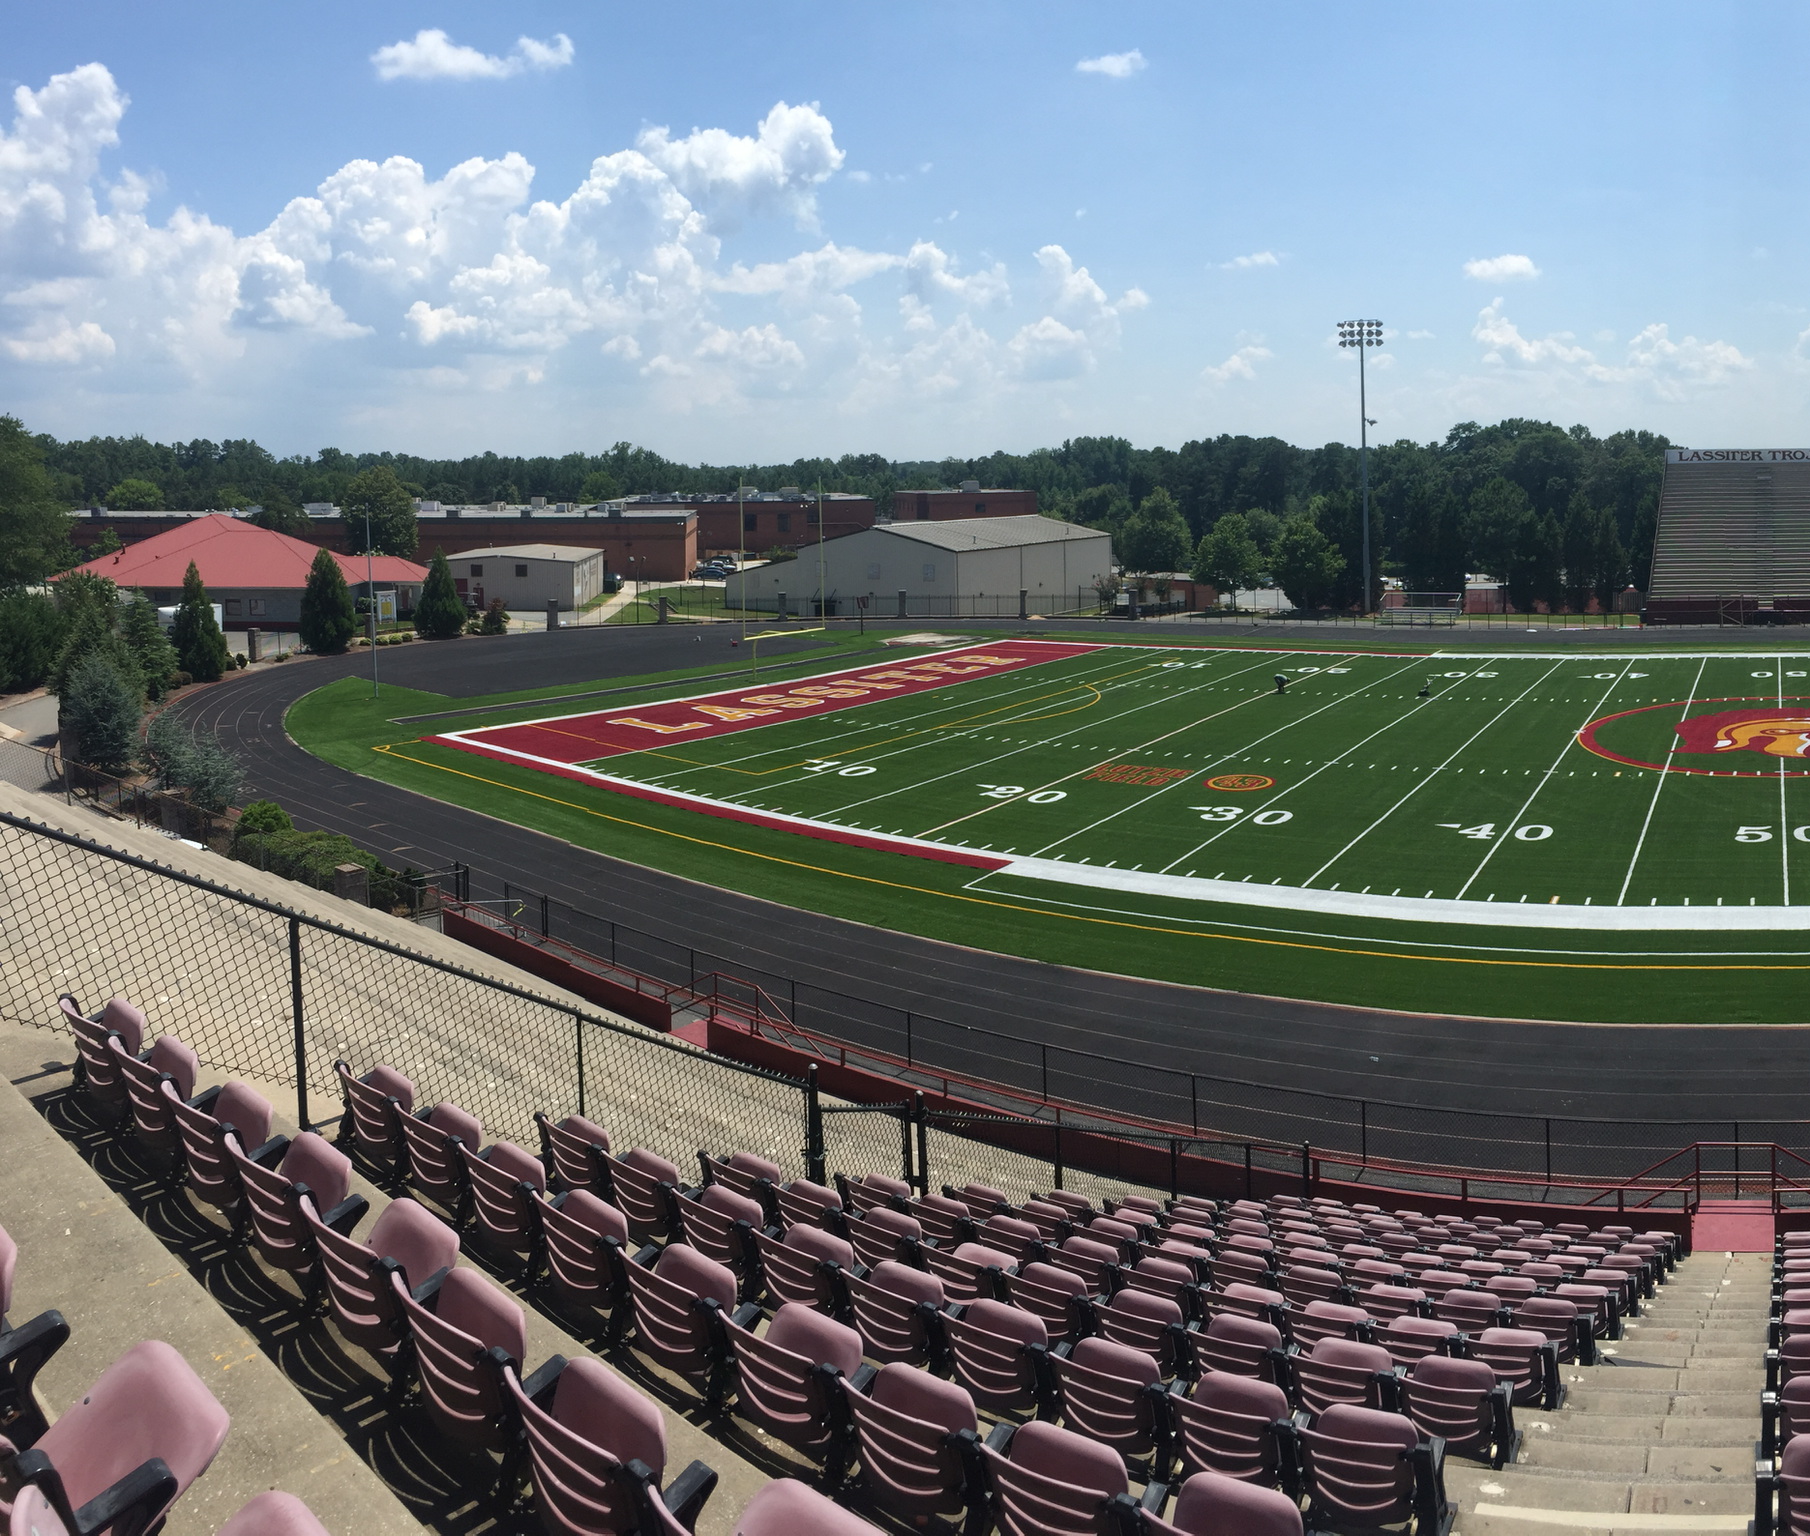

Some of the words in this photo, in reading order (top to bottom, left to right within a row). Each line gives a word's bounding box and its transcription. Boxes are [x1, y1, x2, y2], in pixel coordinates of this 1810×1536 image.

[1678, 451, 1763, 462] LASSITER
[606, 654, 1027, 735] LASSITER
[802, 758, 877, 777] 10
[1096, 763, 1195, 779] LUTZIE
[1082, 771, 1170, 787] FIELD
[980, 784, 1068, 804] 20
[1200, 806, 1294, 826] 30
[1458, 823, 1554, 841] 40
